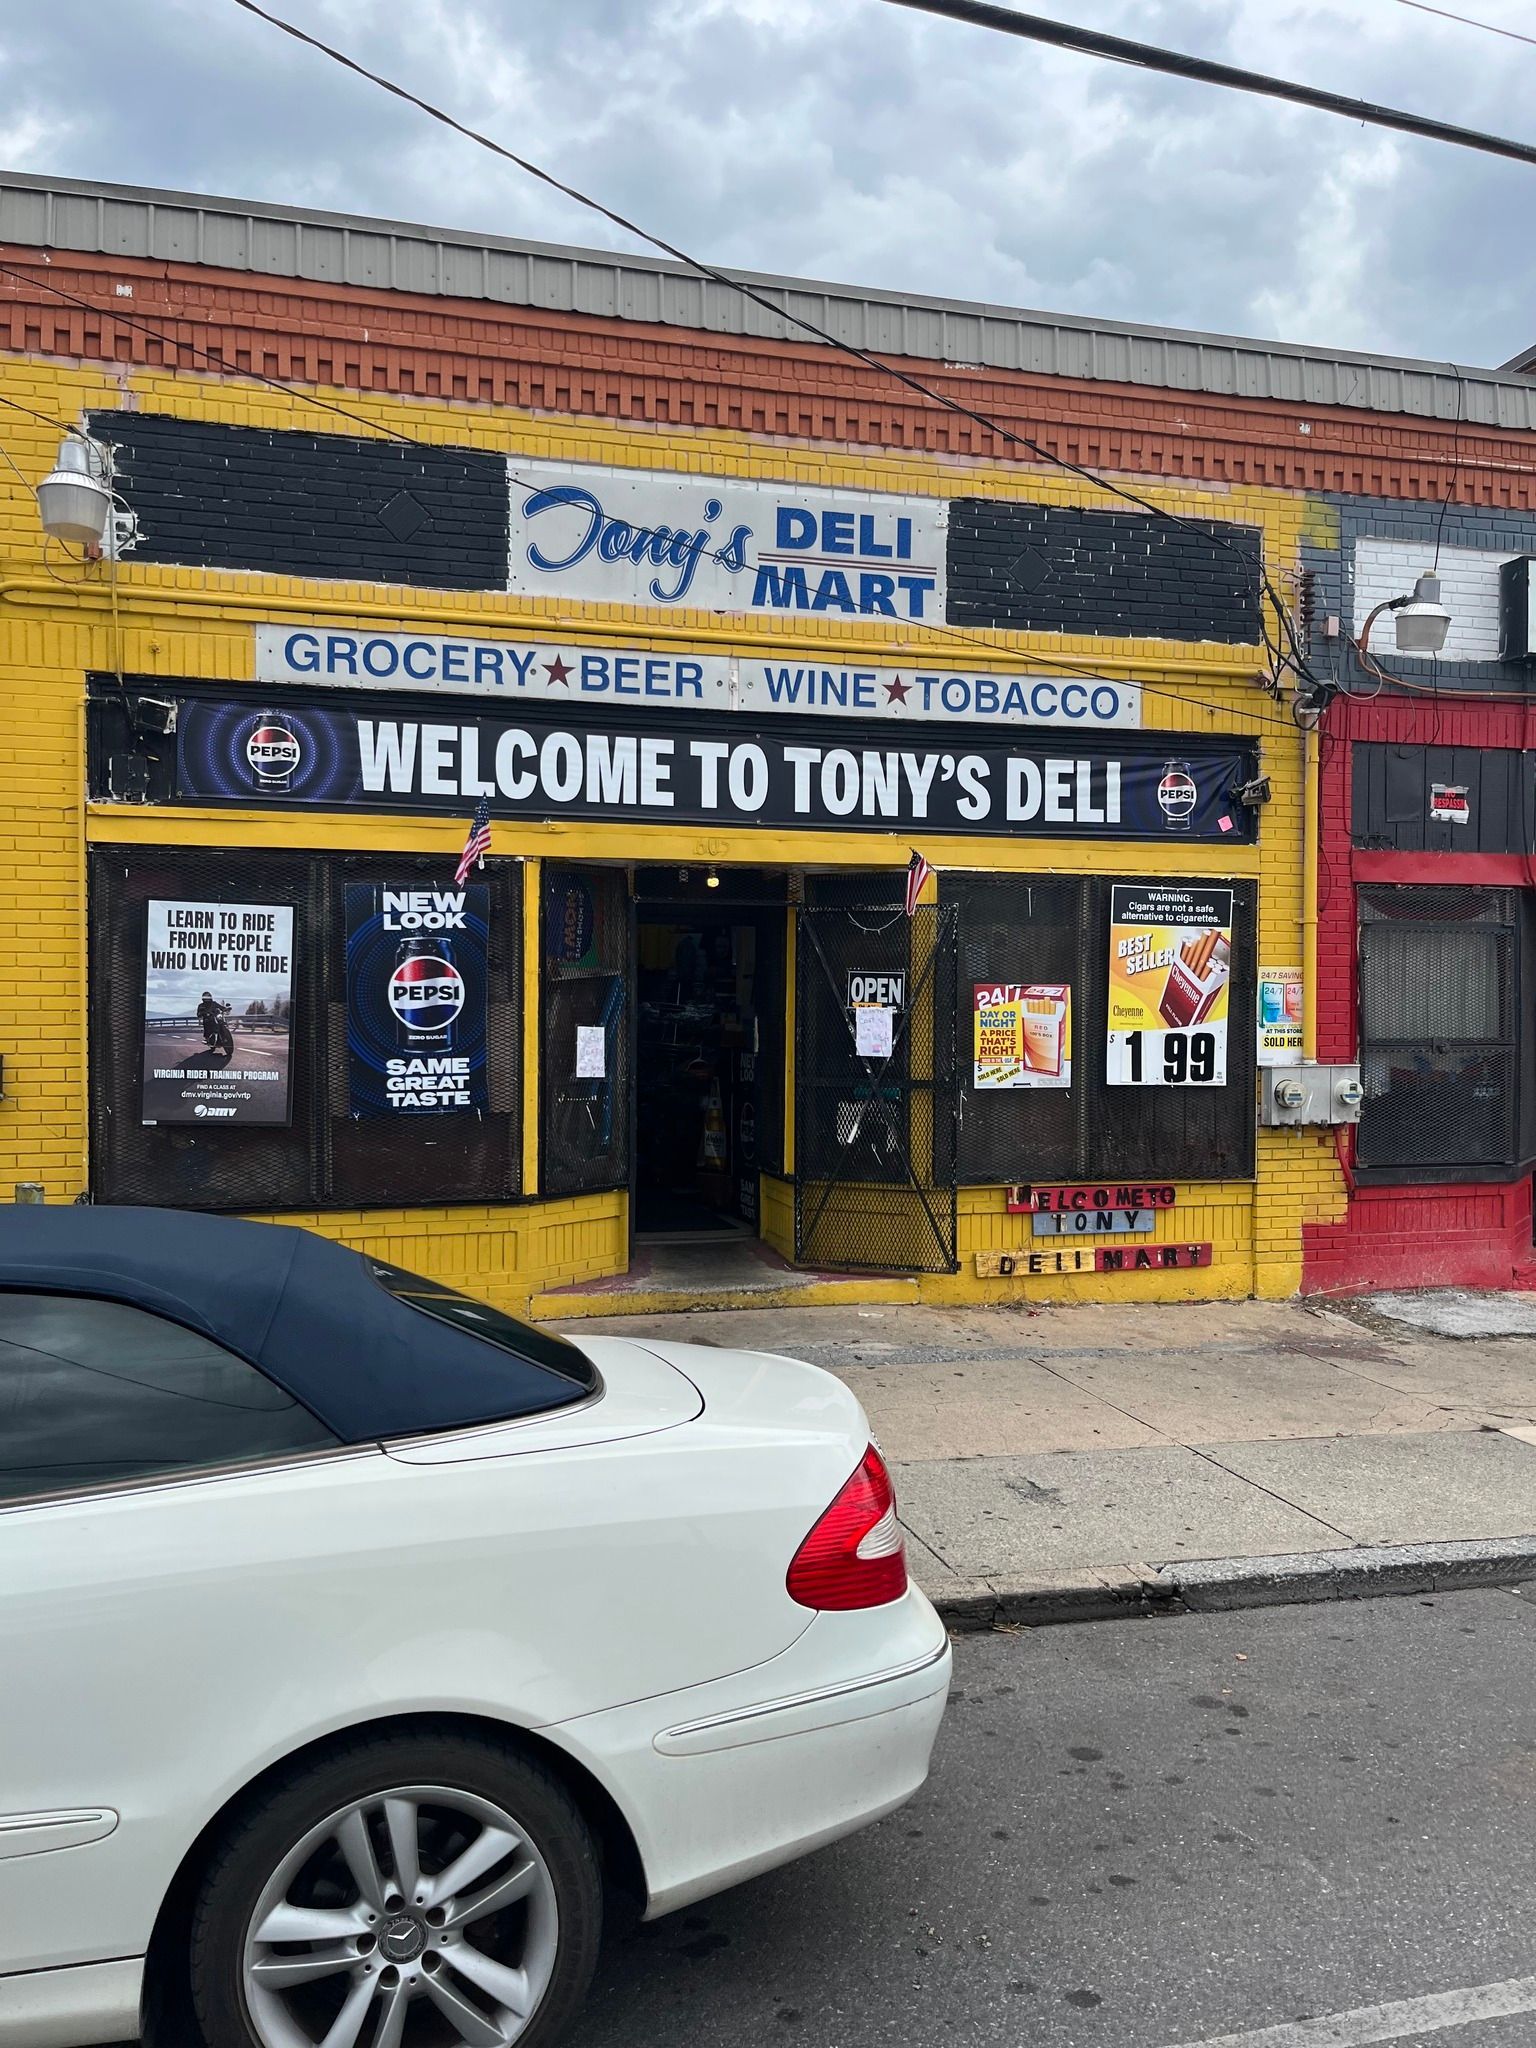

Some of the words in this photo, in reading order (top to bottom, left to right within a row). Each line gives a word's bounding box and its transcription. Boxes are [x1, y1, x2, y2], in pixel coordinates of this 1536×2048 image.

[776, 506, 912, 560] DELI
[521, 484, 753, 603] Tony's
[751, 564, 936, 619] MART
[284, 633, 537, 687] GROCERY
[580, 654, 704, 698] BEER
[764, 667, 877, 708] WINE
[915, 676, 1119, 720] TOBACCO
[250, 745, 297, 758] PEPSI
[357, 720, 675, 807] WELCOME
[690, 740, 769, 812] TO
[783, 746, 991, 821] TONY'S
[1006, 757, 1121, 824] DELI
[1160, 789, 1194, 799] PEPSI
[382, 892, 467, 912] NEW
[1148, 892, 1193, 902] WARNING:
[1128, 902, 1155, 912] Cigars
[1172, 904, 1186, 912] not
[1195, 905, 1214, 913] safe
[167, 909, 214, 929] LEARN
[219, 912, 237, 930] TO
[242, 913, 275, 931] RIDE
[383, 912, 467, 930] LOOK
[1121, 912, 1164, 920] alternative
[1175, 914, 1221, 923] cigarettes.
[169, 930, 213, 950] FROM
[218, 933, 272, 952] PEOPLE
[1118, 933, 1153, 958] BEST
[151, 951, 187, 970] WHO
[191, 952, 228, 971] LOVE
[233, 954, 251, 972] TO
[255, 955, 288, 974] RIDE
[1126, 949, 1174, 975] SELLER
[1171, 965, 1200, 1004] Cheyenne
[1261, 972, 1277, 980] 24/7
[393, 985, 460, 1001] PEPSI
[851, 976, 902, 1004] OPEN
[976, 985, 1021, 1011] 24/7
[1264, 987, 1283, 995] 24/7
[1112, 1005, 1144, 1018] Cheyenne
[980, 1019, 1016, 1028] NIGHT
[980, 1038, 1016, 1046] THAT'S
[980, 1046, 1016, 1055] RIGHT
[1264, 1037, 1285, 1047] SOLD
[1287, 1037, 1303, 1047] HER
[385, 1057, 470, 1076] SAME
[1163, 1032, 1215, 1083] 99
[153, 1069, 185, 1079] VIRGINIA
[186, 1069, 208, 1080] RIDER
[209, 1070, 242, 1080] TRAINING
[243, 1070, 279, 1081] PROGRAM
[386, 1075, 470, 1091] GREAT
[386, 1091, 470, 1107] TASTE
[1052, 1211, 1139, 1233] TONY
[1000, 1251, 1081, 1275] DELI
[1104, 1246, 1202, 1272] MART
